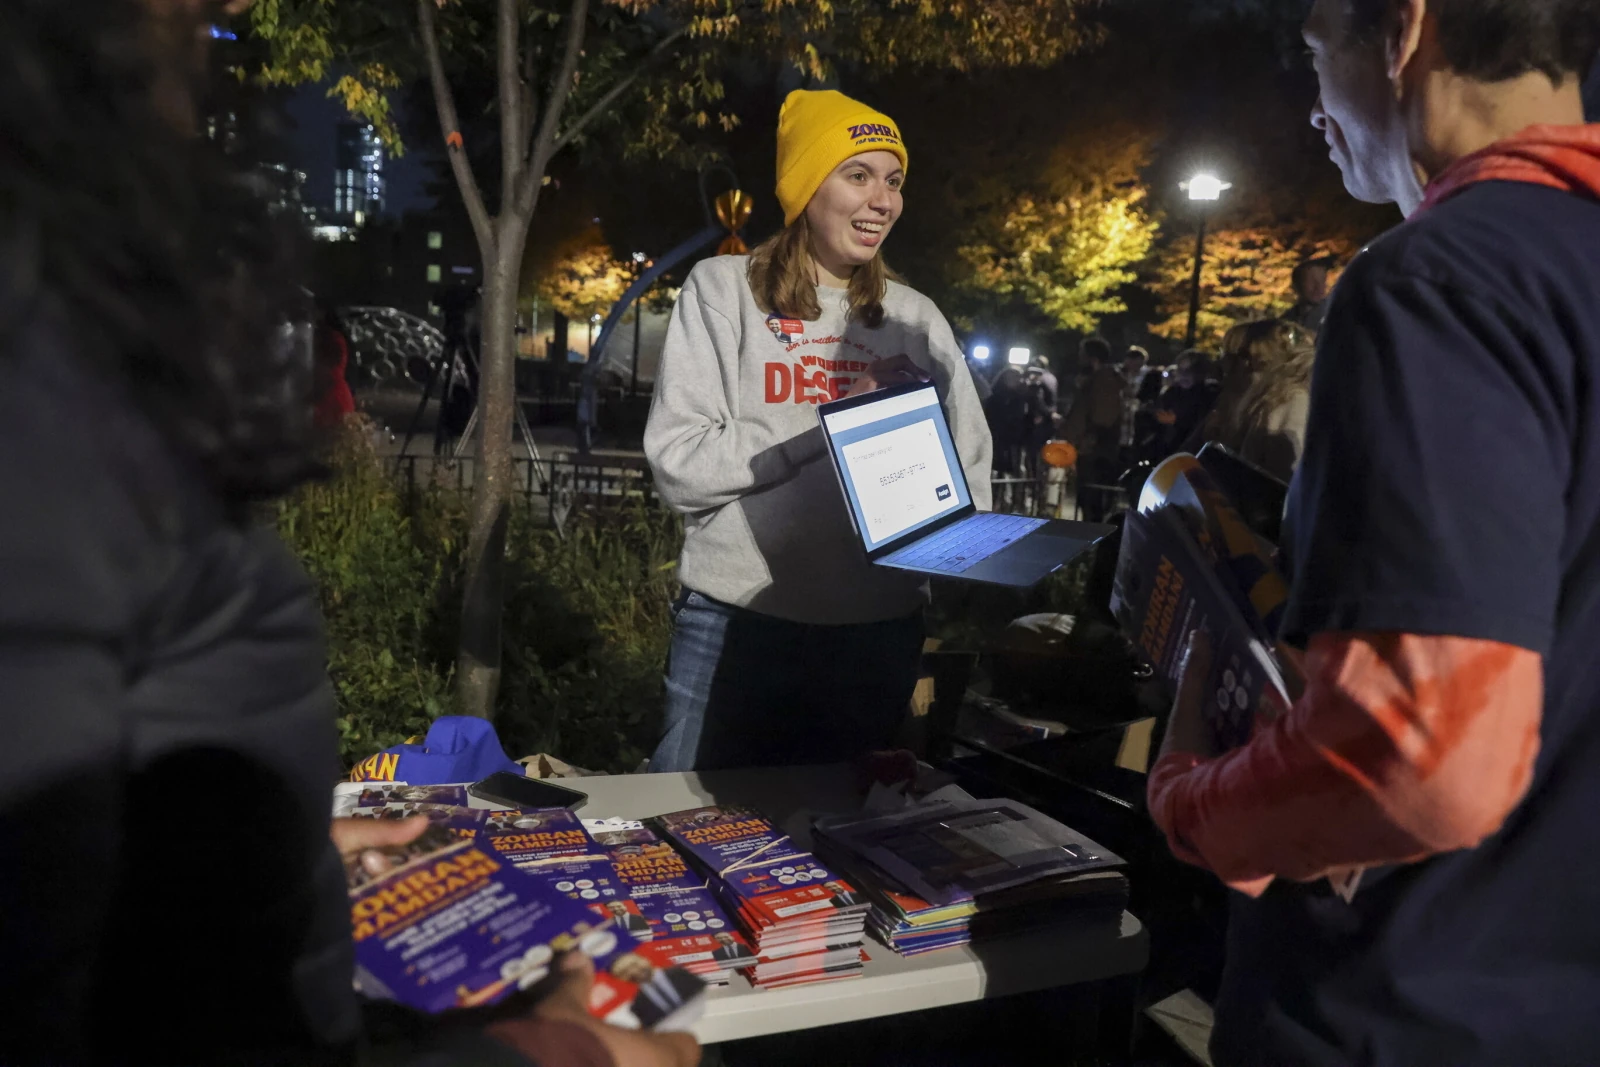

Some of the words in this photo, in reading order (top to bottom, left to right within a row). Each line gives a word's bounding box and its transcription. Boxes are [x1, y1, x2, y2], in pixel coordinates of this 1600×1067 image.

[680, 819, 764, 839] ZOHRAN
[688, 825, 771, 845] MAMDANI
[489, 830, 586, 845] ZOHRAN
[494, 837, 588, 851] MAMDANI
[610, 857, 684, 871] OHRAN
[617, 865, 688, 878] AMDANI
[352, 849, 486, 918] OHRAN
